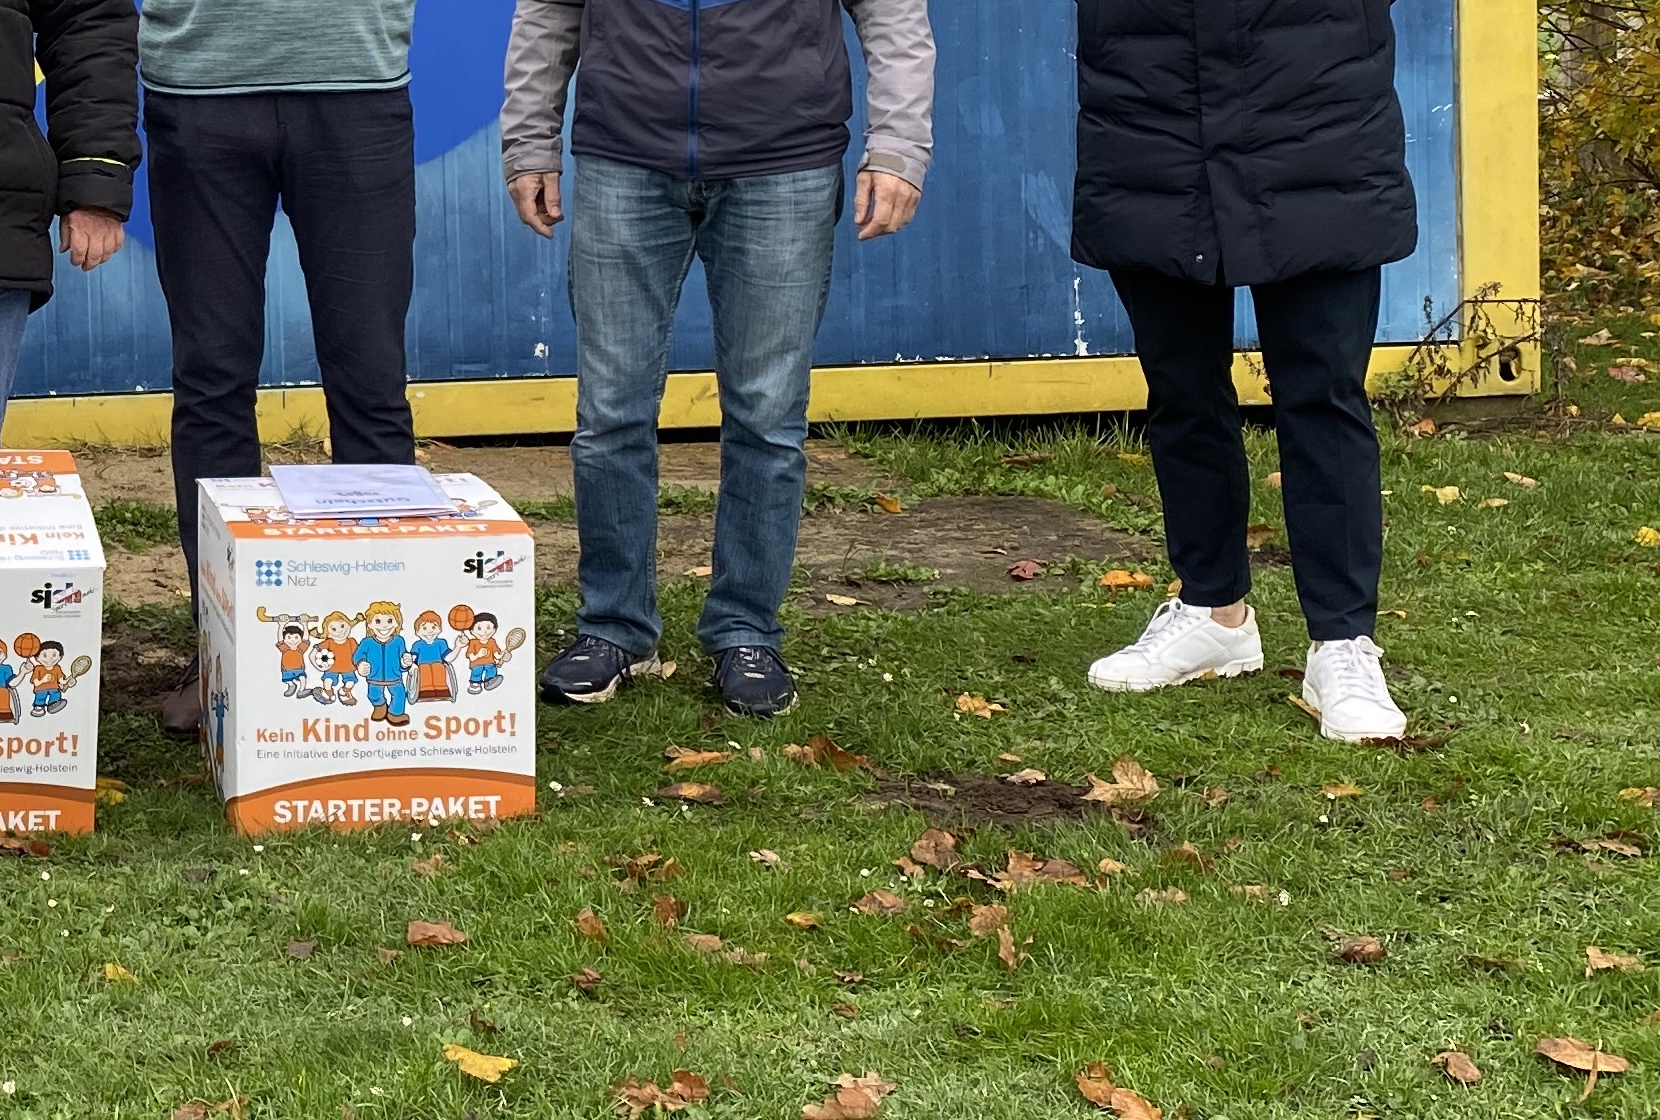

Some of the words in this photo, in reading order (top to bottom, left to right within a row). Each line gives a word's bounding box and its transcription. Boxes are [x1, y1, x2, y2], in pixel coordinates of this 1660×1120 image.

[263, 524, 488, 536] STARTER-PAKET
[287, 560, 405, 576] Schleswig-Holstein
[287, 575, 317, 587] Netz
[256, 728, 295, 742] Kein
[302, 718, 369, 742] Kind
[375, 727, 418, 741] ohne
[423, 710, 516, 740] Sport!
[257, 749, 280, 759] Eine
[283, 749, 328, 758] Initiative
[332, 749, 349, 758] der
[352, 748, 416, 759] Sportjugend
[420, 744, 517, 756] Schleswig-Holstein
[273, 795, 501, 823] STARTER-PAKET
